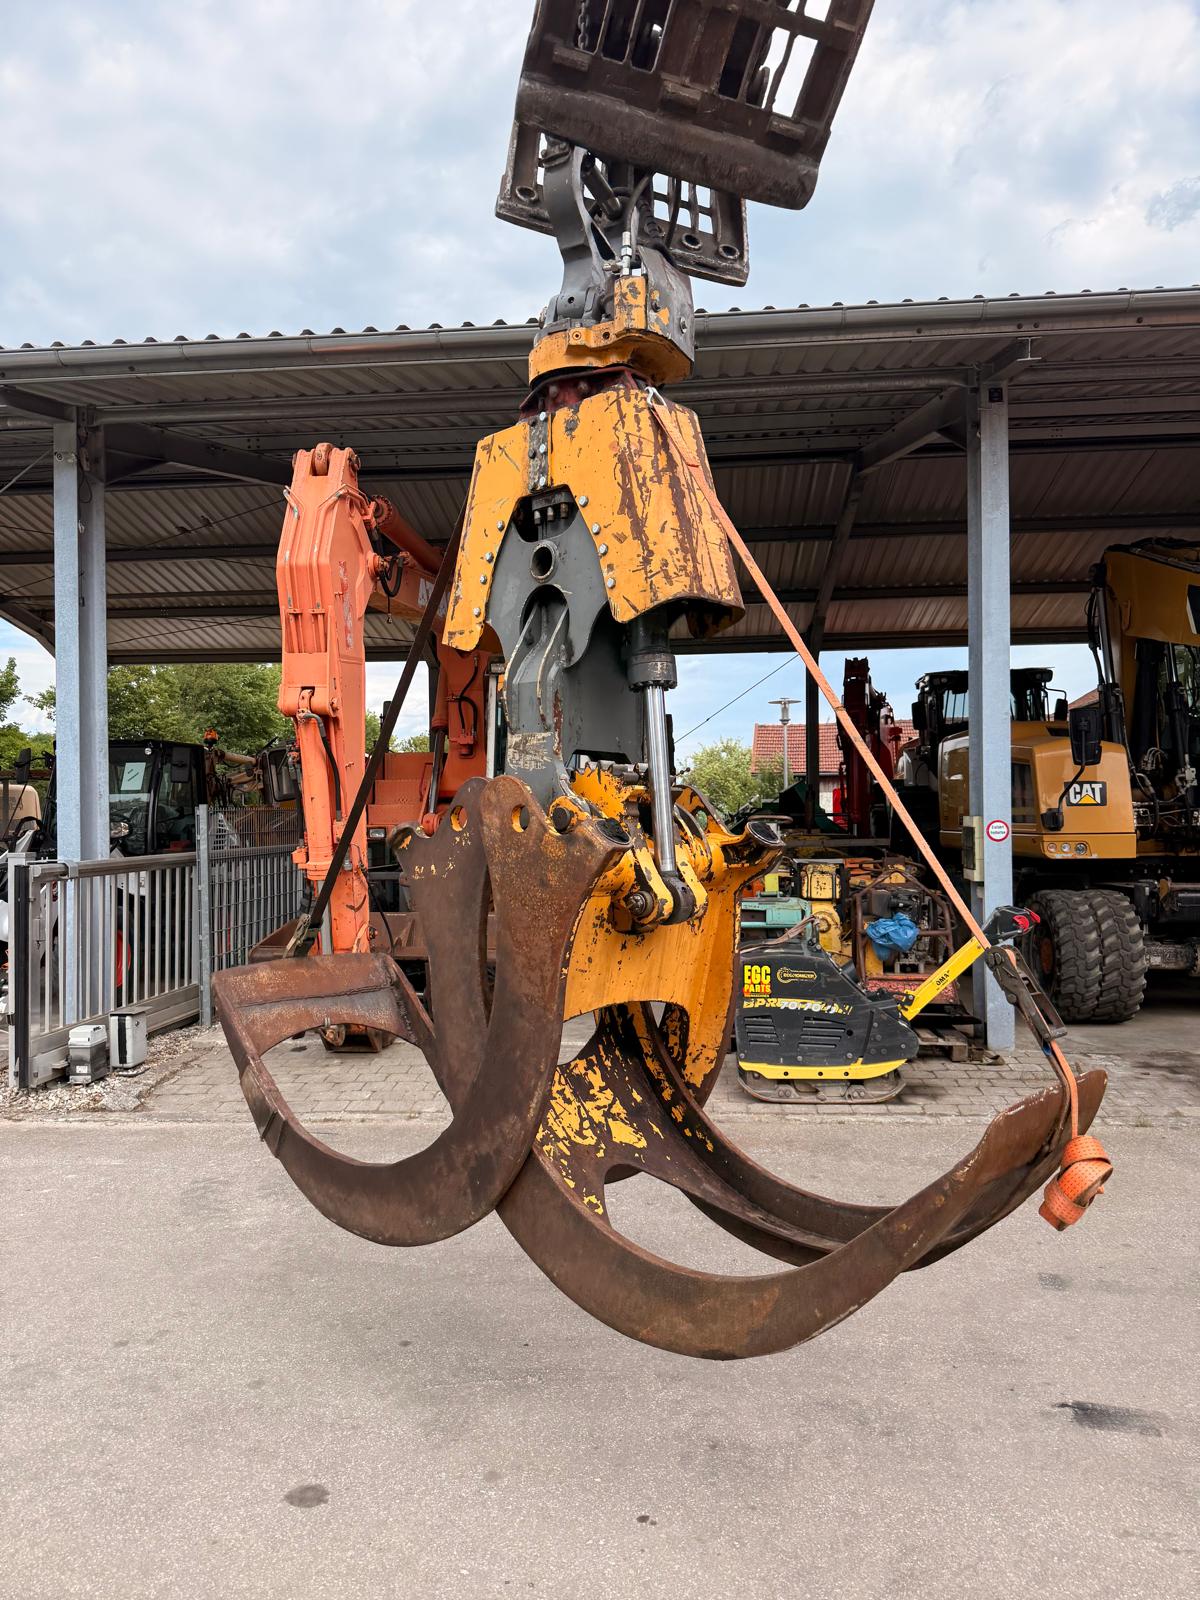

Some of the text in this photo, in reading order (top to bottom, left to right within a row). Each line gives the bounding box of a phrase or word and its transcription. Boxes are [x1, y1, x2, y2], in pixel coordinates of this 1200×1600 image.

[1069, 783, 1103, 804] CAT
[744, 965, 771, 985] EGC
[744, 984, 772, 993] PARTS
